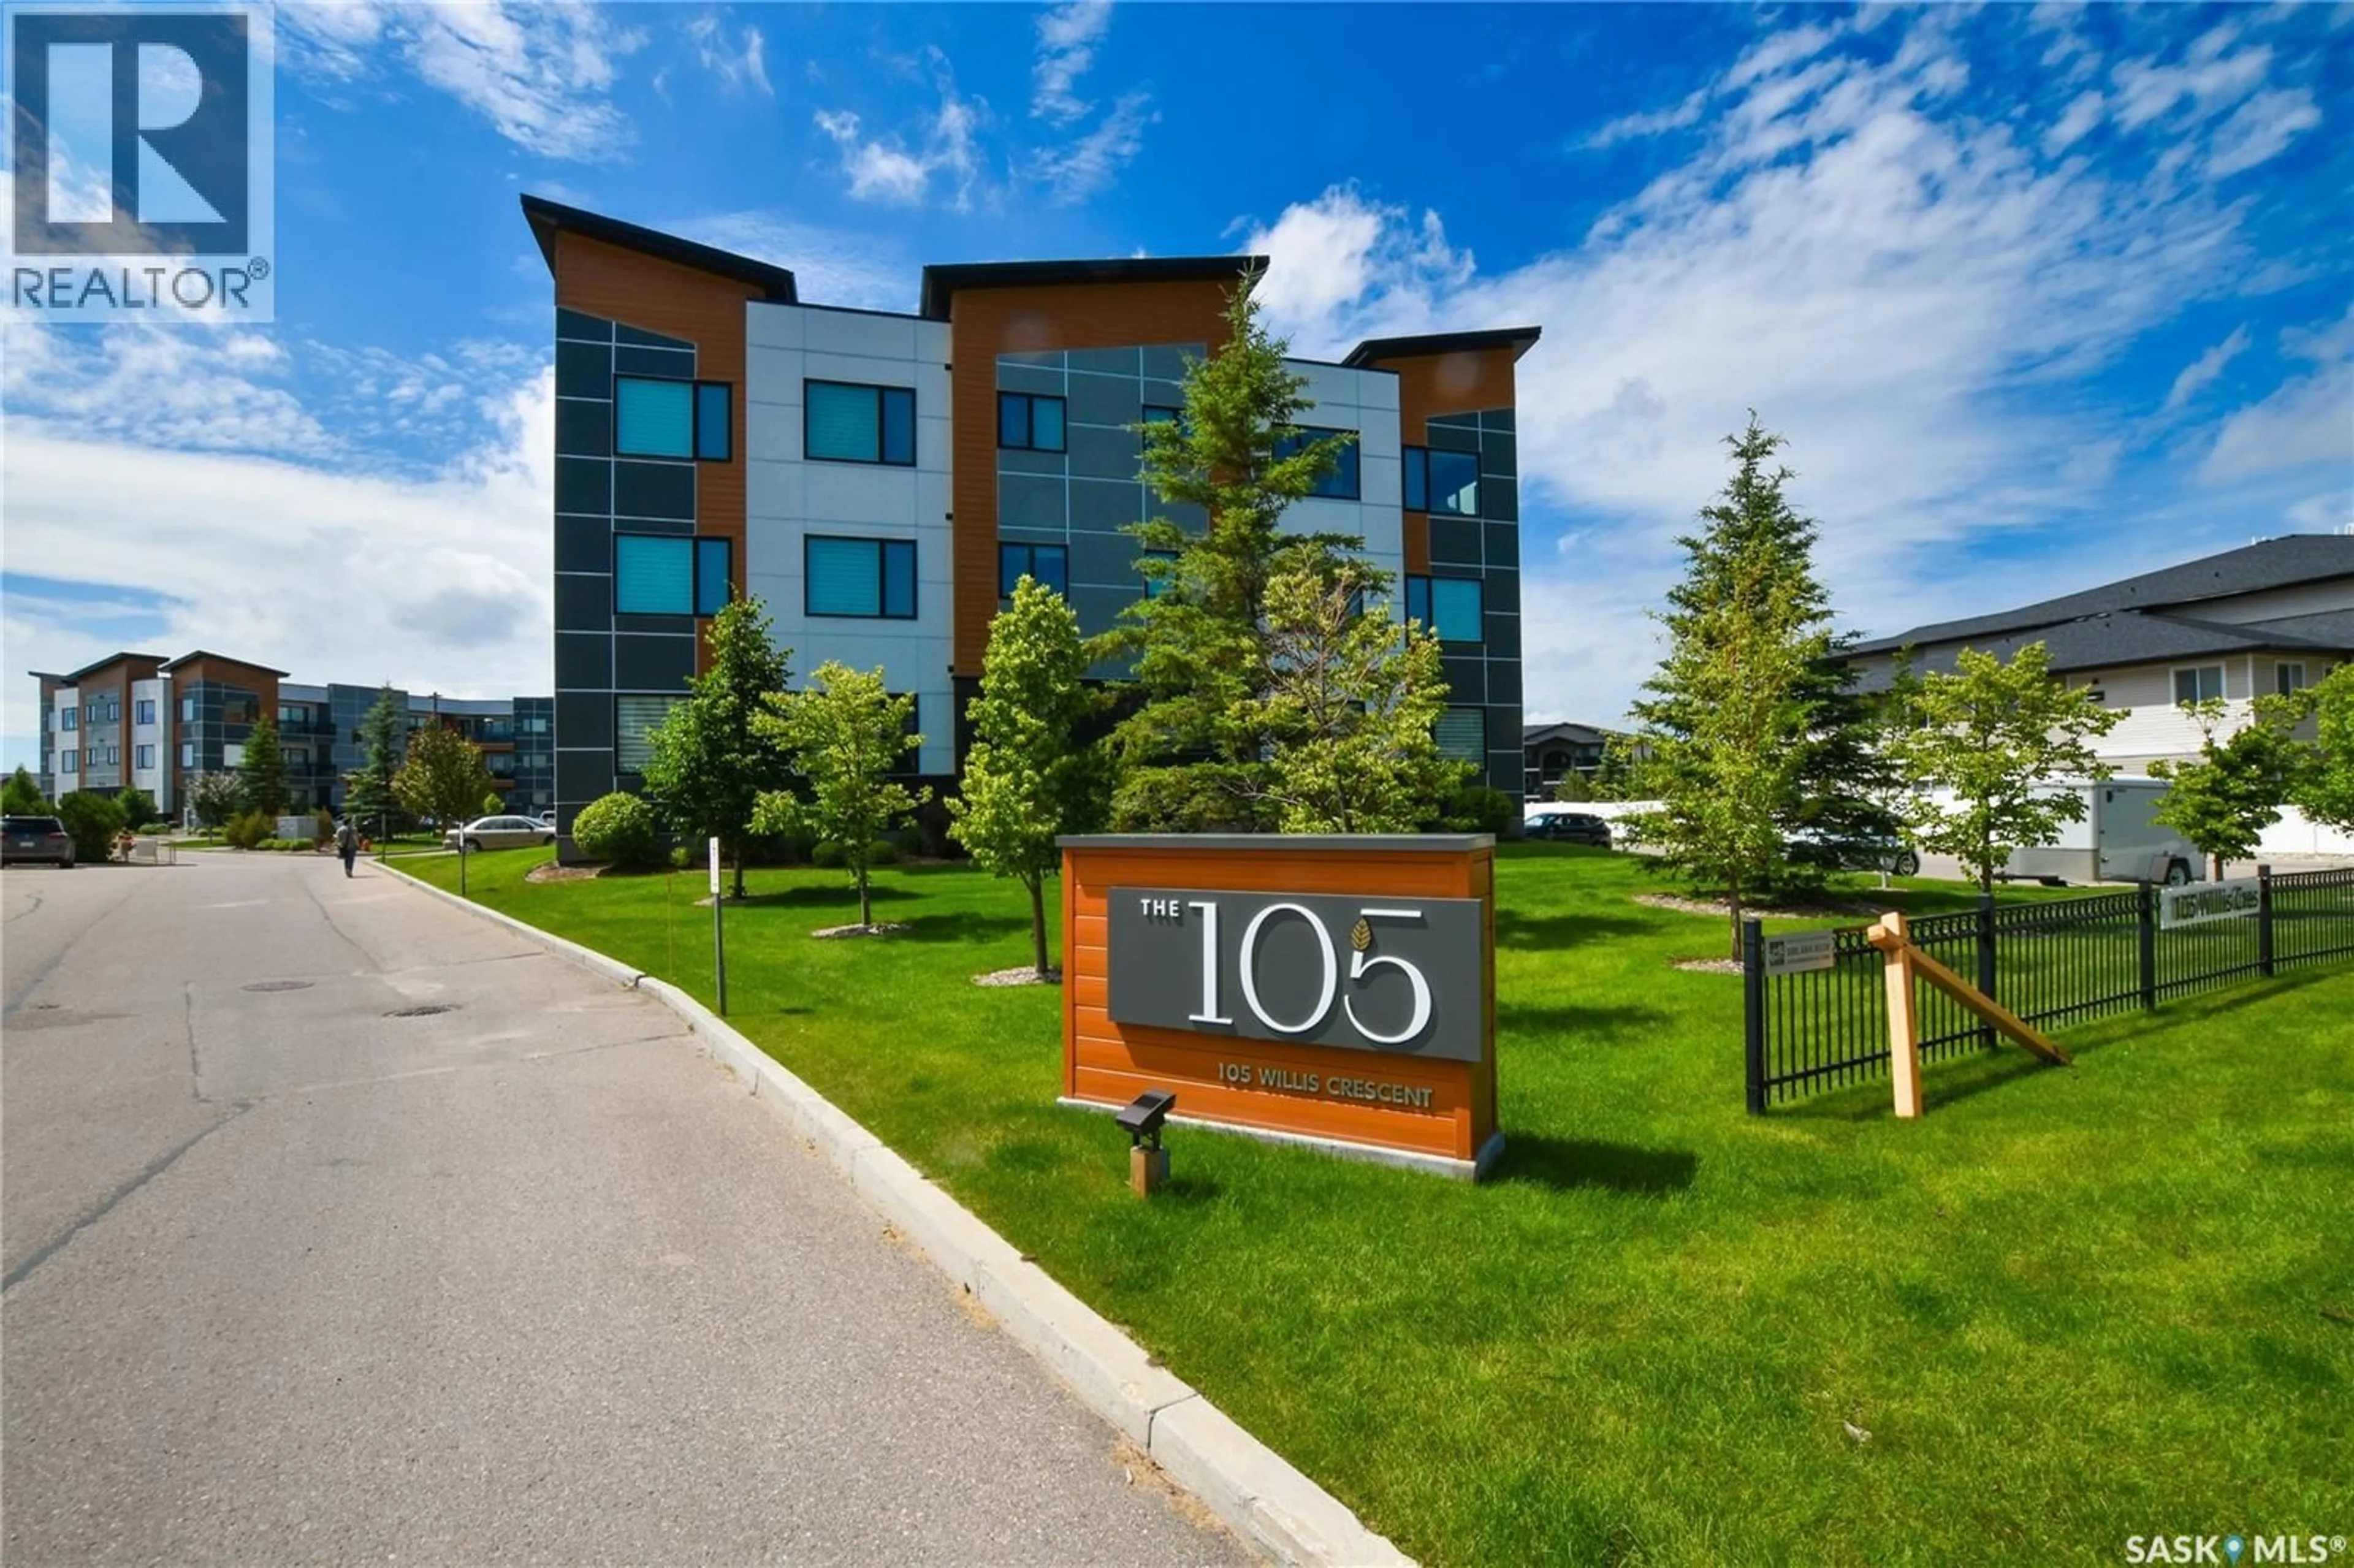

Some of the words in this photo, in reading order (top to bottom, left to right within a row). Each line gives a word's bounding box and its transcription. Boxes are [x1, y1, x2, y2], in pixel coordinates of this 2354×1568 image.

[1140, 899, 1179, 916] THE
[1188, 901, 1431, 1043] 105
[1219, 1062, 1251, 1083] 105
[1259, 1067, 1319, 1092] WILLIS
[1327, 1076, 1432, 1107] CRESCENT
